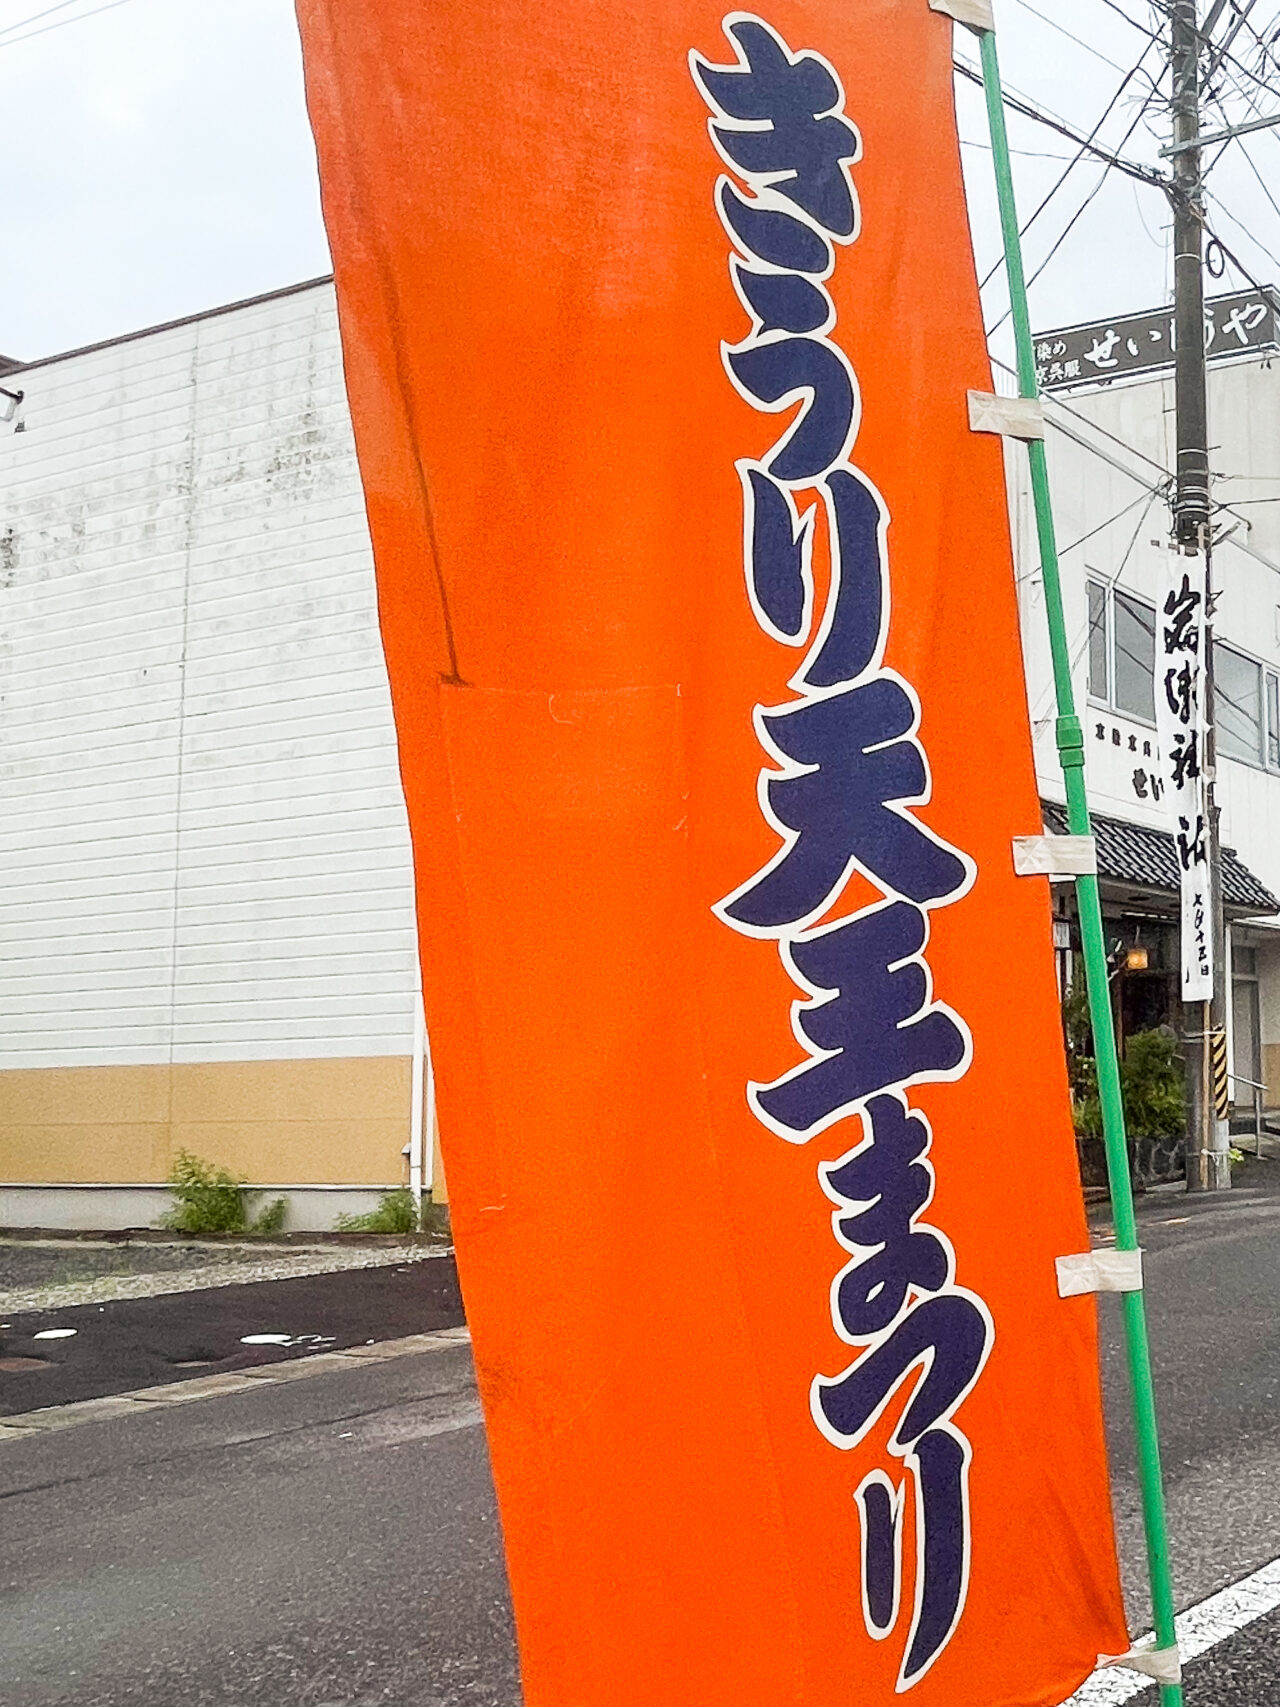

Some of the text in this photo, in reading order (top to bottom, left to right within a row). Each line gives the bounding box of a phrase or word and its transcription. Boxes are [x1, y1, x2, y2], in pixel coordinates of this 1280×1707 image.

[1033, 339, 1067, 362] 染め
[688, 12, 995, 1692] きうり天王まつり
